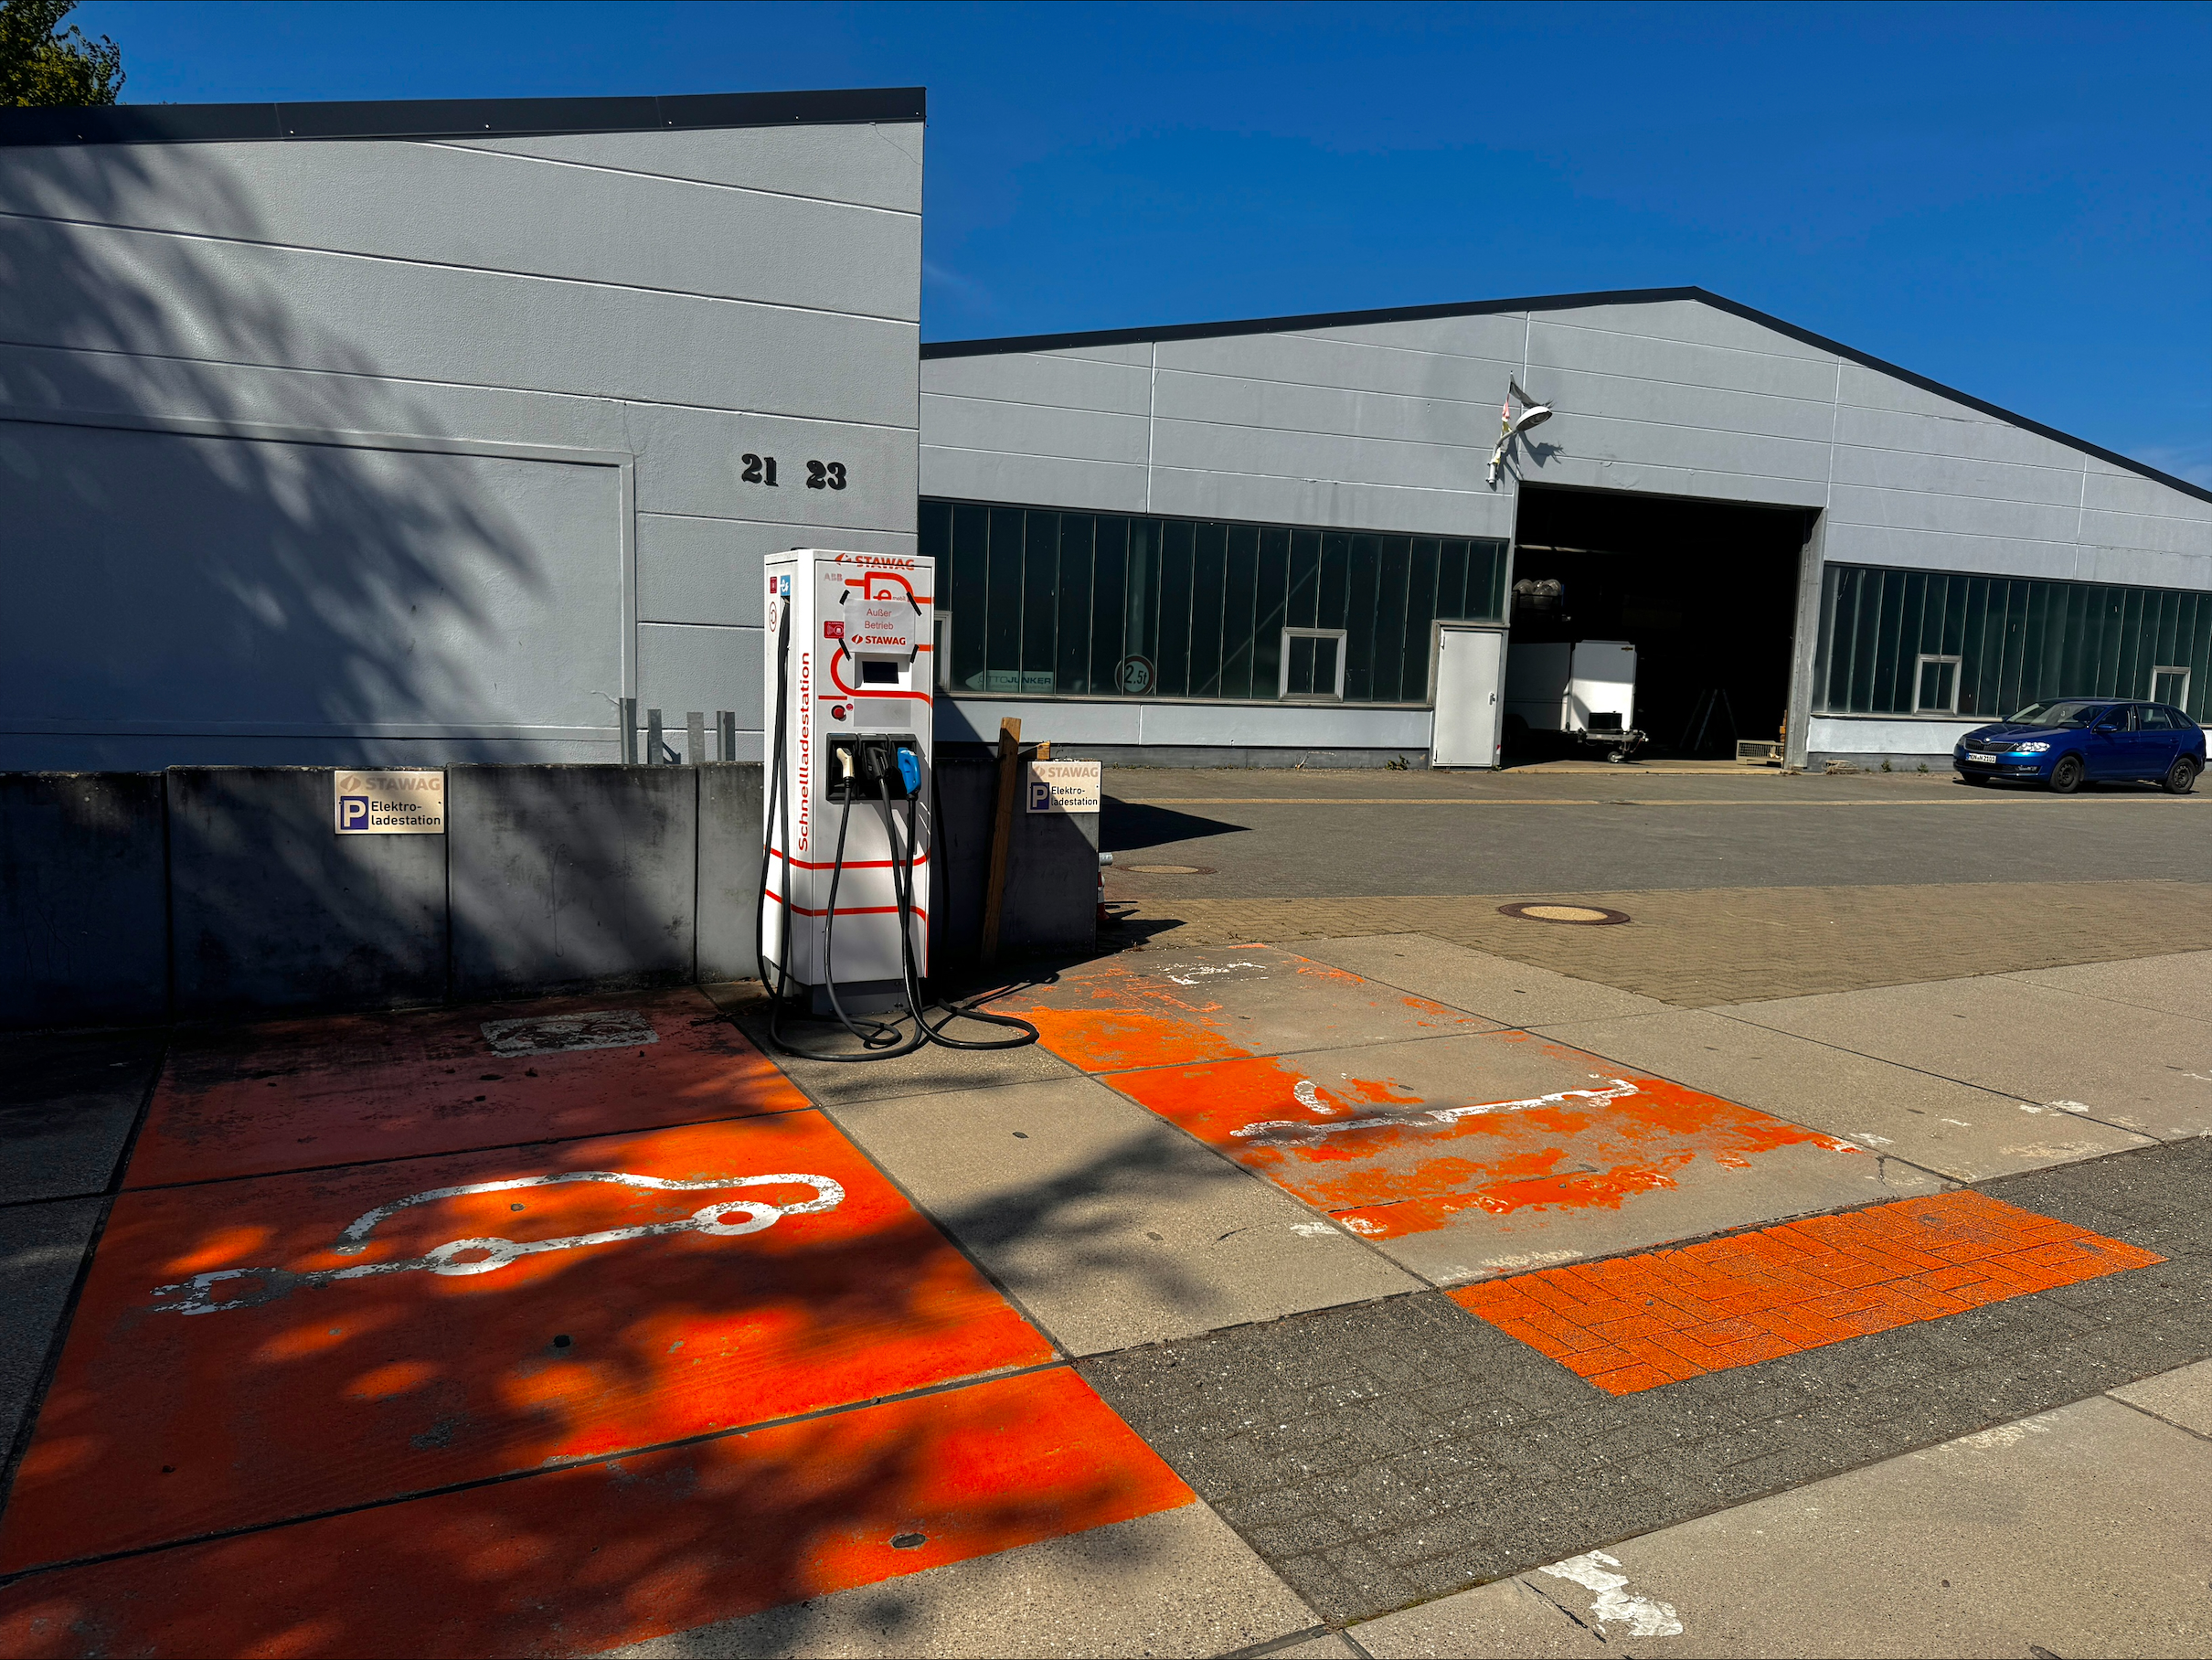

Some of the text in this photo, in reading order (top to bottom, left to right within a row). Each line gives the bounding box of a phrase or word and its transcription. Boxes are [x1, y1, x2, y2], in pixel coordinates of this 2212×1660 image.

[741, 453, 846, 491] 21 23
[855, 556, 915, 571] STAWAG
[824, 573, 843, 581] ABB
[867, 608, 892, 618] Außer
[865, 621, 894, 631] Betrieb
[866, 635, 906, 645] STAWAG
[799, 652, 810, 852] Schnellladestation
[1048, 766, 1099, 778] STAWAG
[367, 777, 441, 791] STAWAG
[1051, 786, 1085, 795] Elektro-
[1033, 785, 1048, 808] P
[1051, 797, 1098, 806] ladestation
[371, 801, 422, 812] Elektro-
[344, 800, 366, 827] P
[371, 815, 441, 825] ladestation
